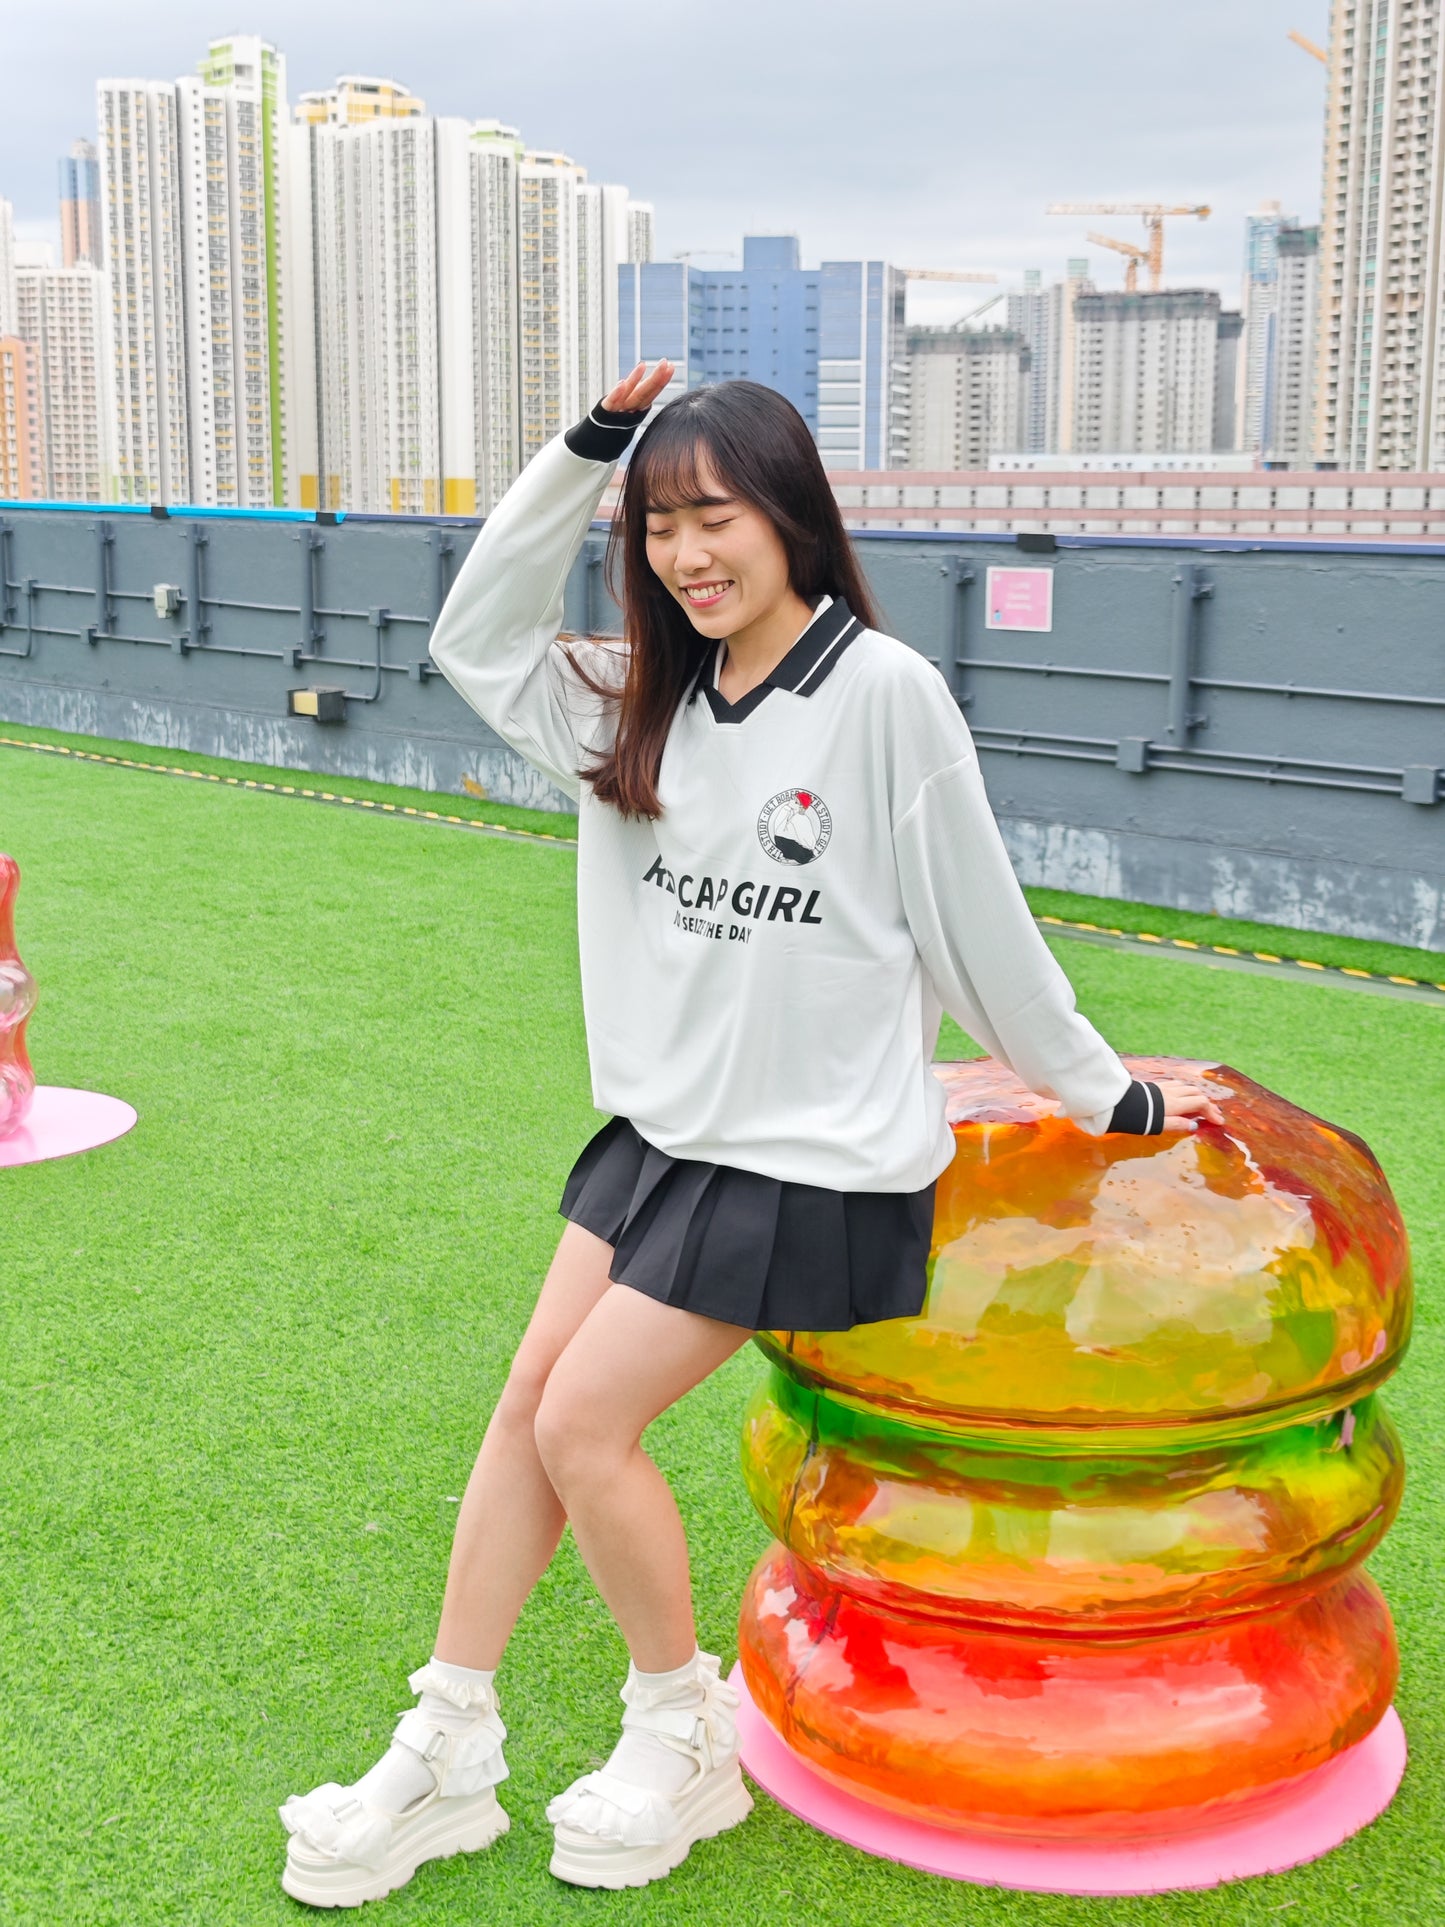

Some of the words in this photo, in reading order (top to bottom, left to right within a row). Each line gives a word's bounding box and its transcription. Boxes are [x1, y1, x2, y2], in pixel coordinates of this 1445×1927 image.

[759, 818, 771, 847] STUDY
[763, 800, 776, 816] GET
[818, 807, 831, 836] STUDY
[731, 881, 822, 924] GIRL
[729, 924, 752, 944] DAY
